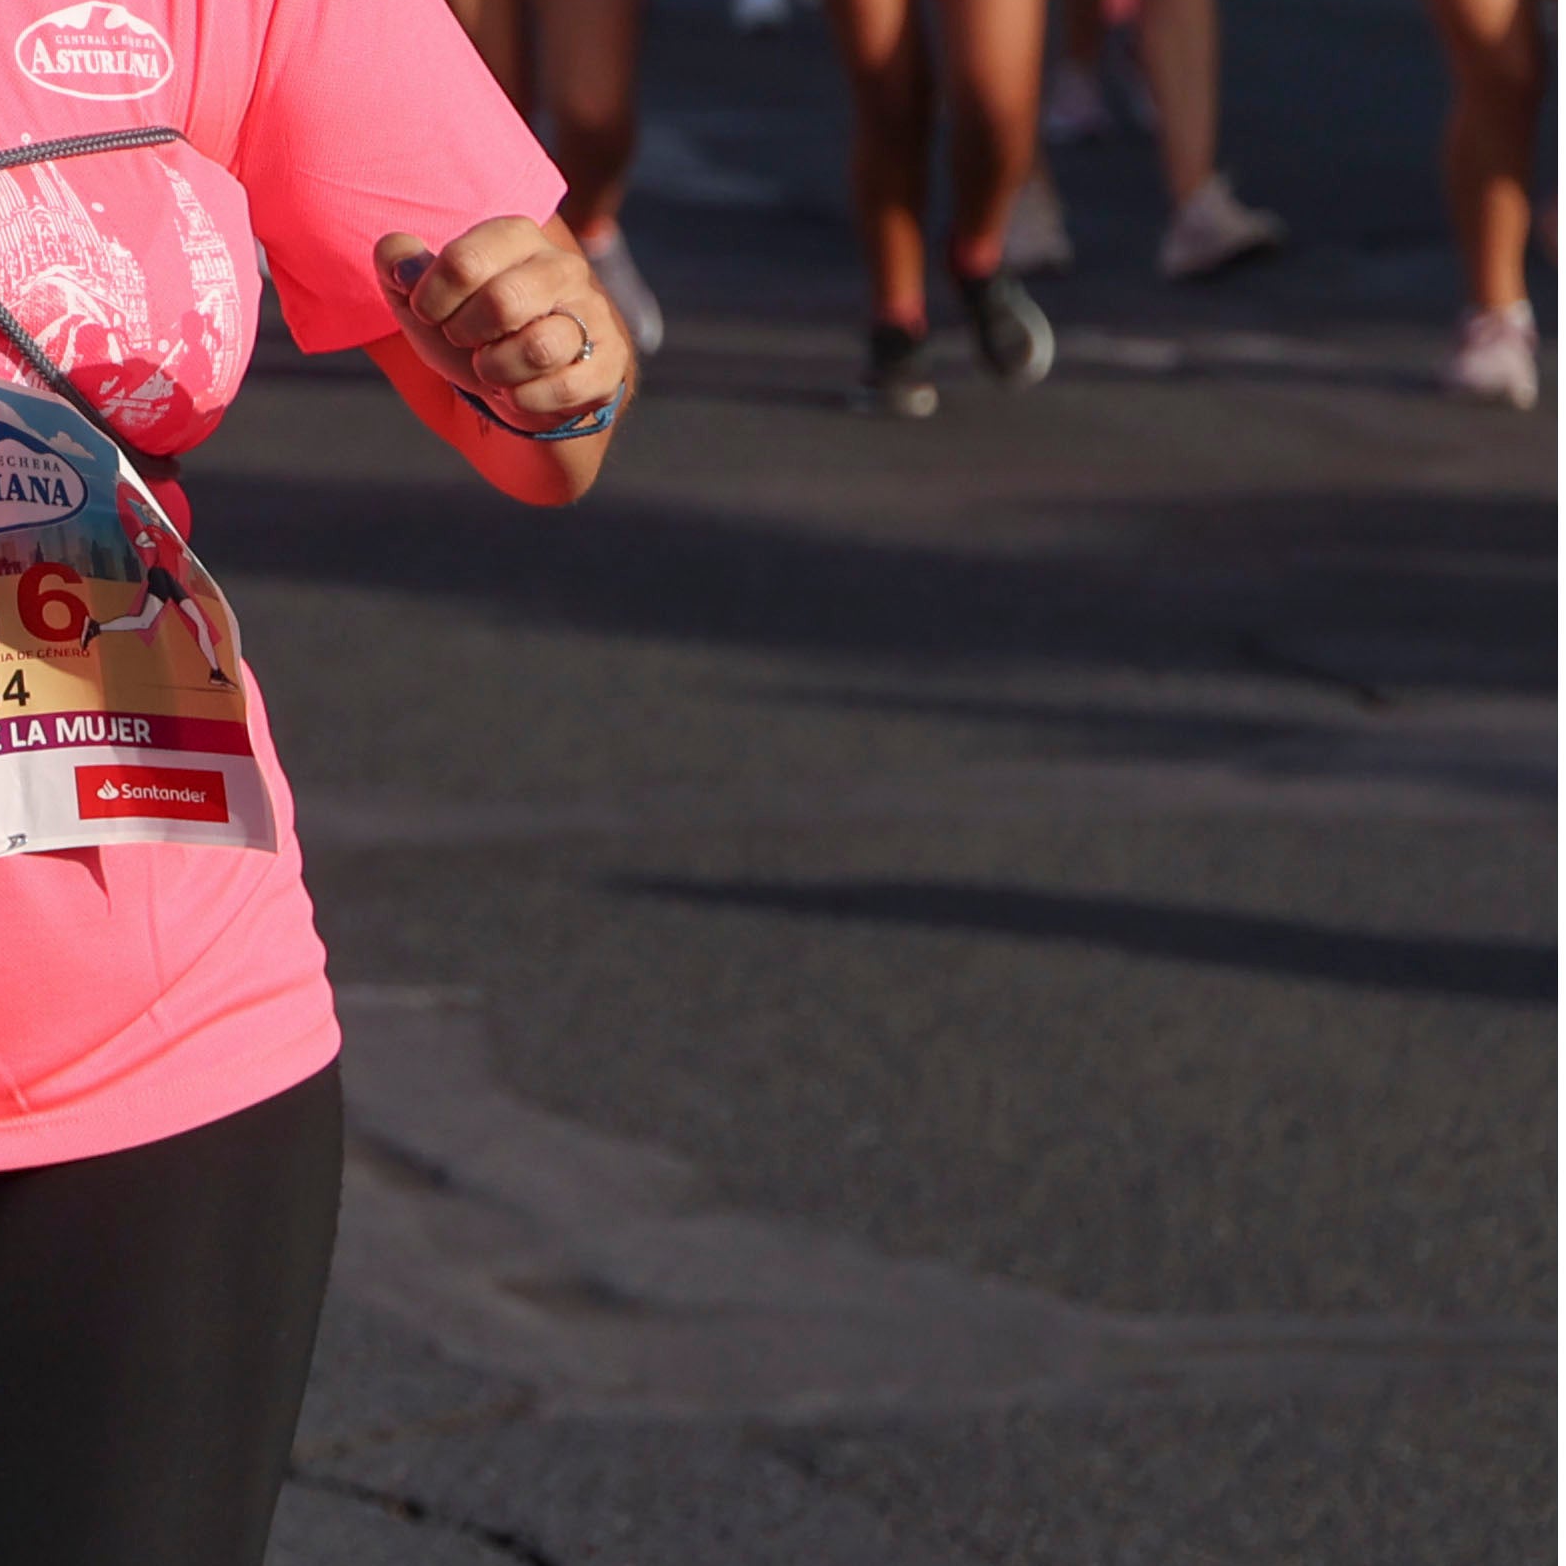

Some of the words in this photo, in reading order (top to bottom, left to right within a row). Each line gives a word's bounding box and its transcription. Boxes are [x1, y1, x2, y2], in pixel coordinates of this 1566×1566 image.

[55, 34, 108, 46] CENTRAL
[17, 650, 34, 662] DE
[9, 718, 47, 749] LA
[55, 714, 153, 745] MUJER
[120, 782, 208, 804] Santander
